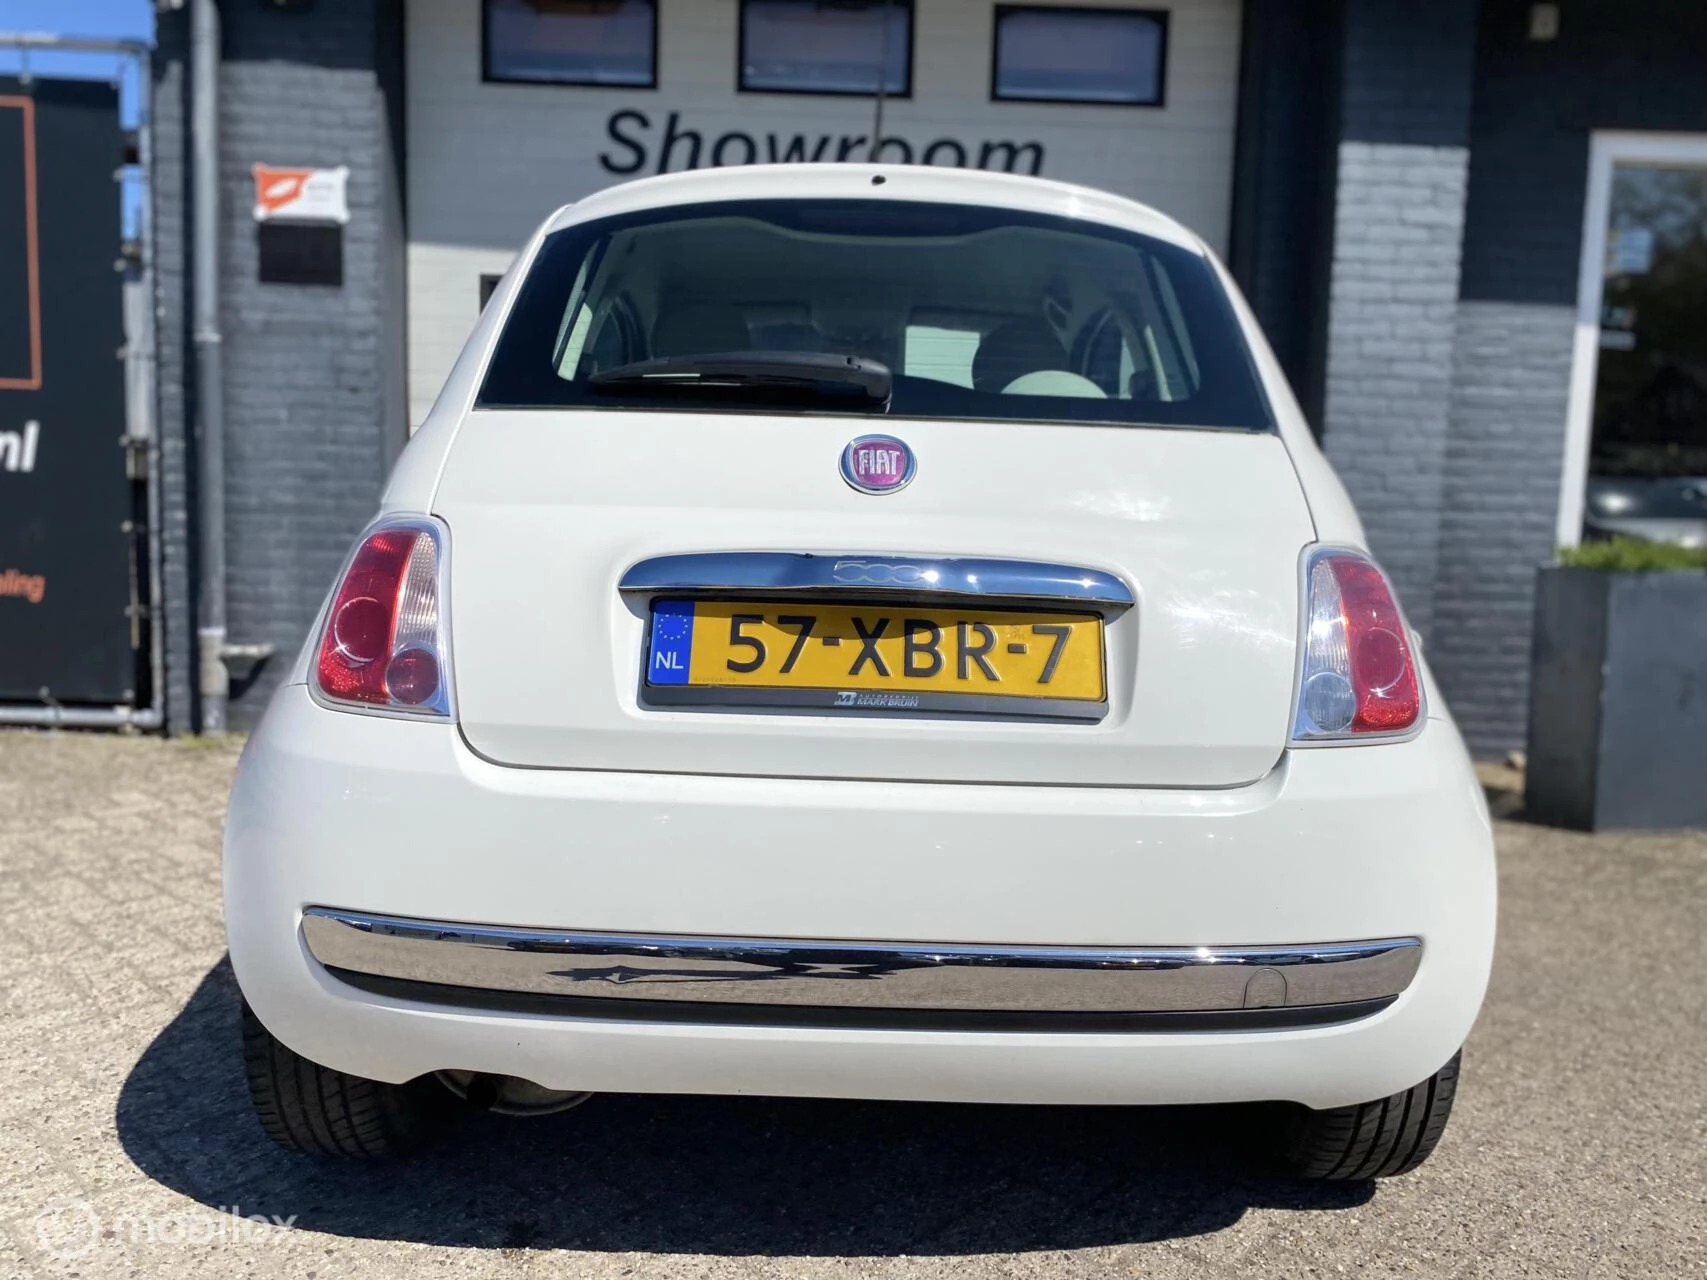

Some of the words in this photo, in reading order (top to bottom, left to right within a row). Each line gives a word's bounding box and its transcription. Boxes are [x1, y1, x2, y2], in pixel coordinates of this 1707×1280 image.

[598, 109, 1045, 176] Showroom
[858, 449, 901, 475] FIAT
[833, 560, 922, 584] 500
[655, 651, 684, 670] NL
[727, 614, 1073, 683] 57-XBR-7
[857, 697, 887, 706] MARK
